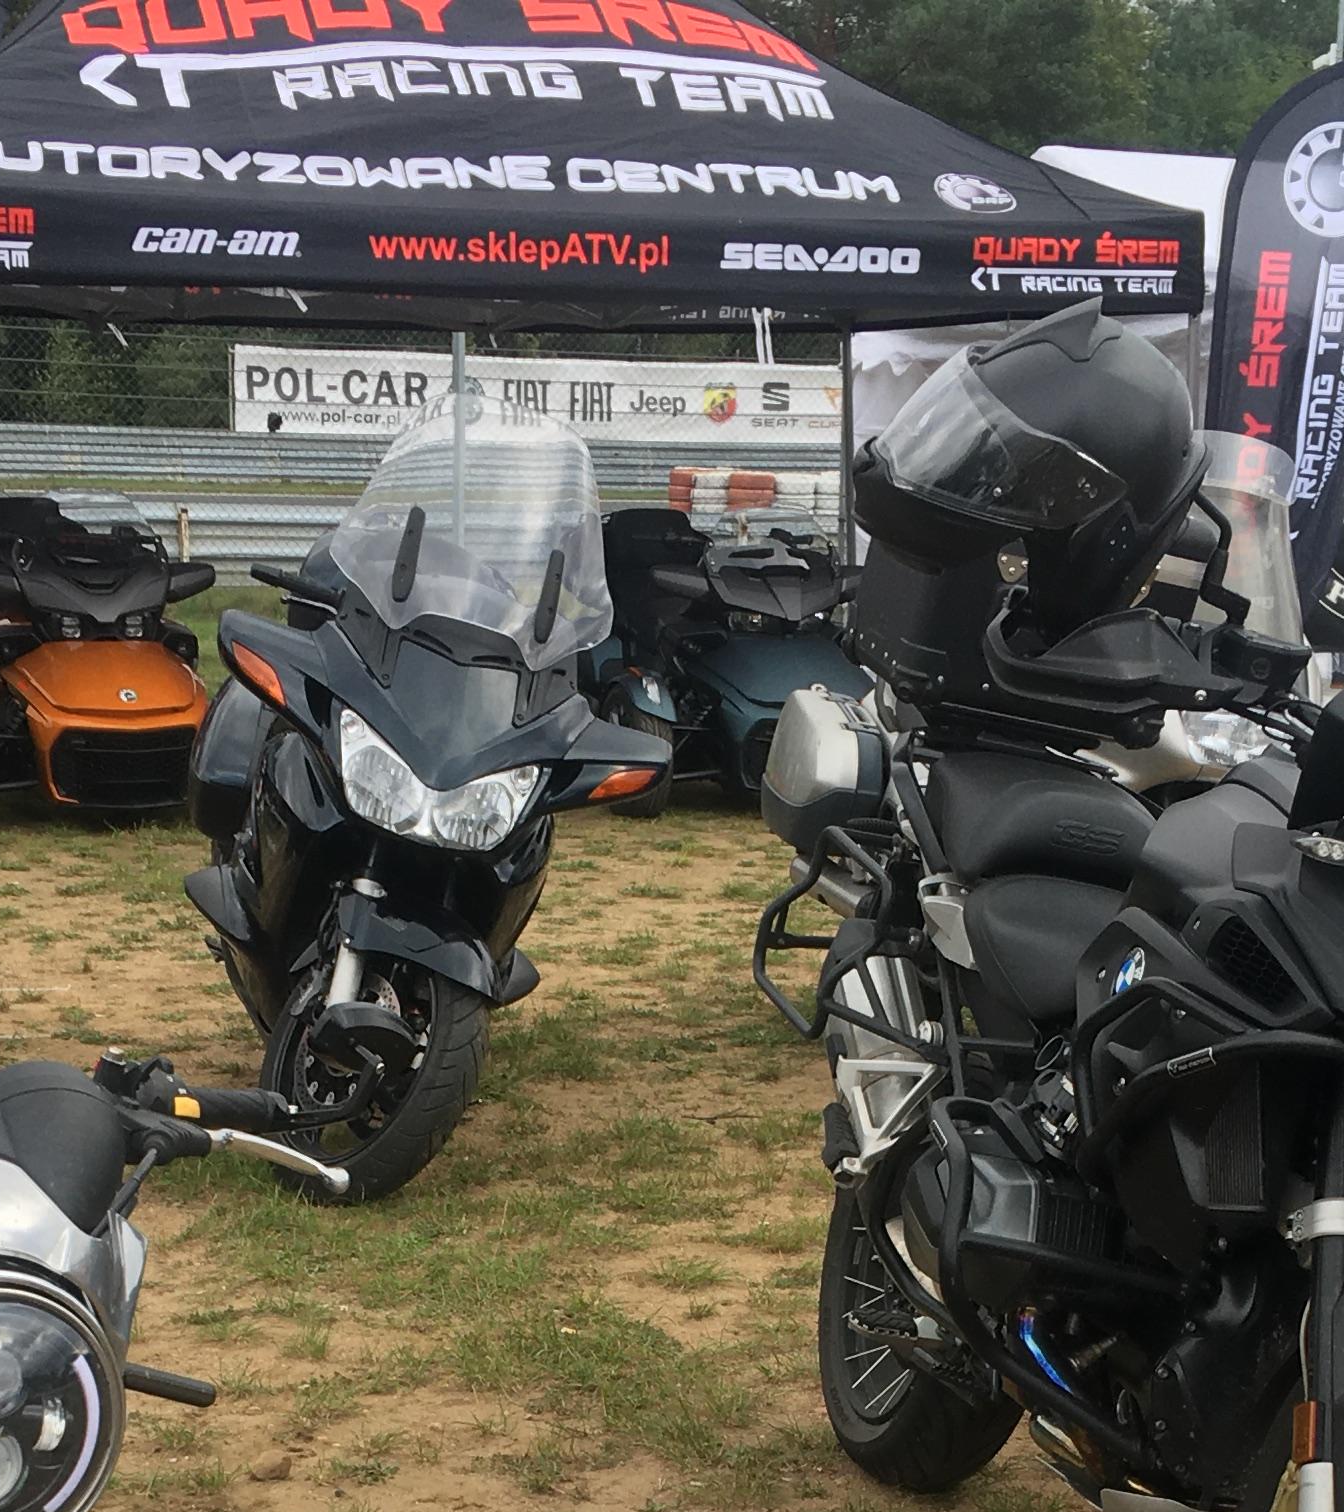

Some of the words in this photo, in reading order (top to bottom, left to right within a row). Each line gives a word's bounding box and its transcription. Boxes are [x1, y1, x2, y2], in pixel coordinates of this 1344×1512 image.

[272, 60, 584, 111] RACING
[618, 66, 835, 122] TEAM
[566, 158, 901, 203] CENTRUM
[131, 227, 302, 258] can-am
[369, 232, 671, 274] www.sklepATV.pl
[973, 236, 1081, 266] QUADY
[1096, 231, 1180, 267] ŚREM
[1021, 275, 1103, 295] RACING
[1114, 277, 1174, 296] TEAM
[1239, 251, 1292, 387] ŚREM
[246, 365, 428, 406] POL-CAR
[569, 381, 615, 422] FIAT
[630, 389, 687, 417] Jeep
[752, 418, 799, 428] SEAT
[1295, 374, 1335, 500] RACING
